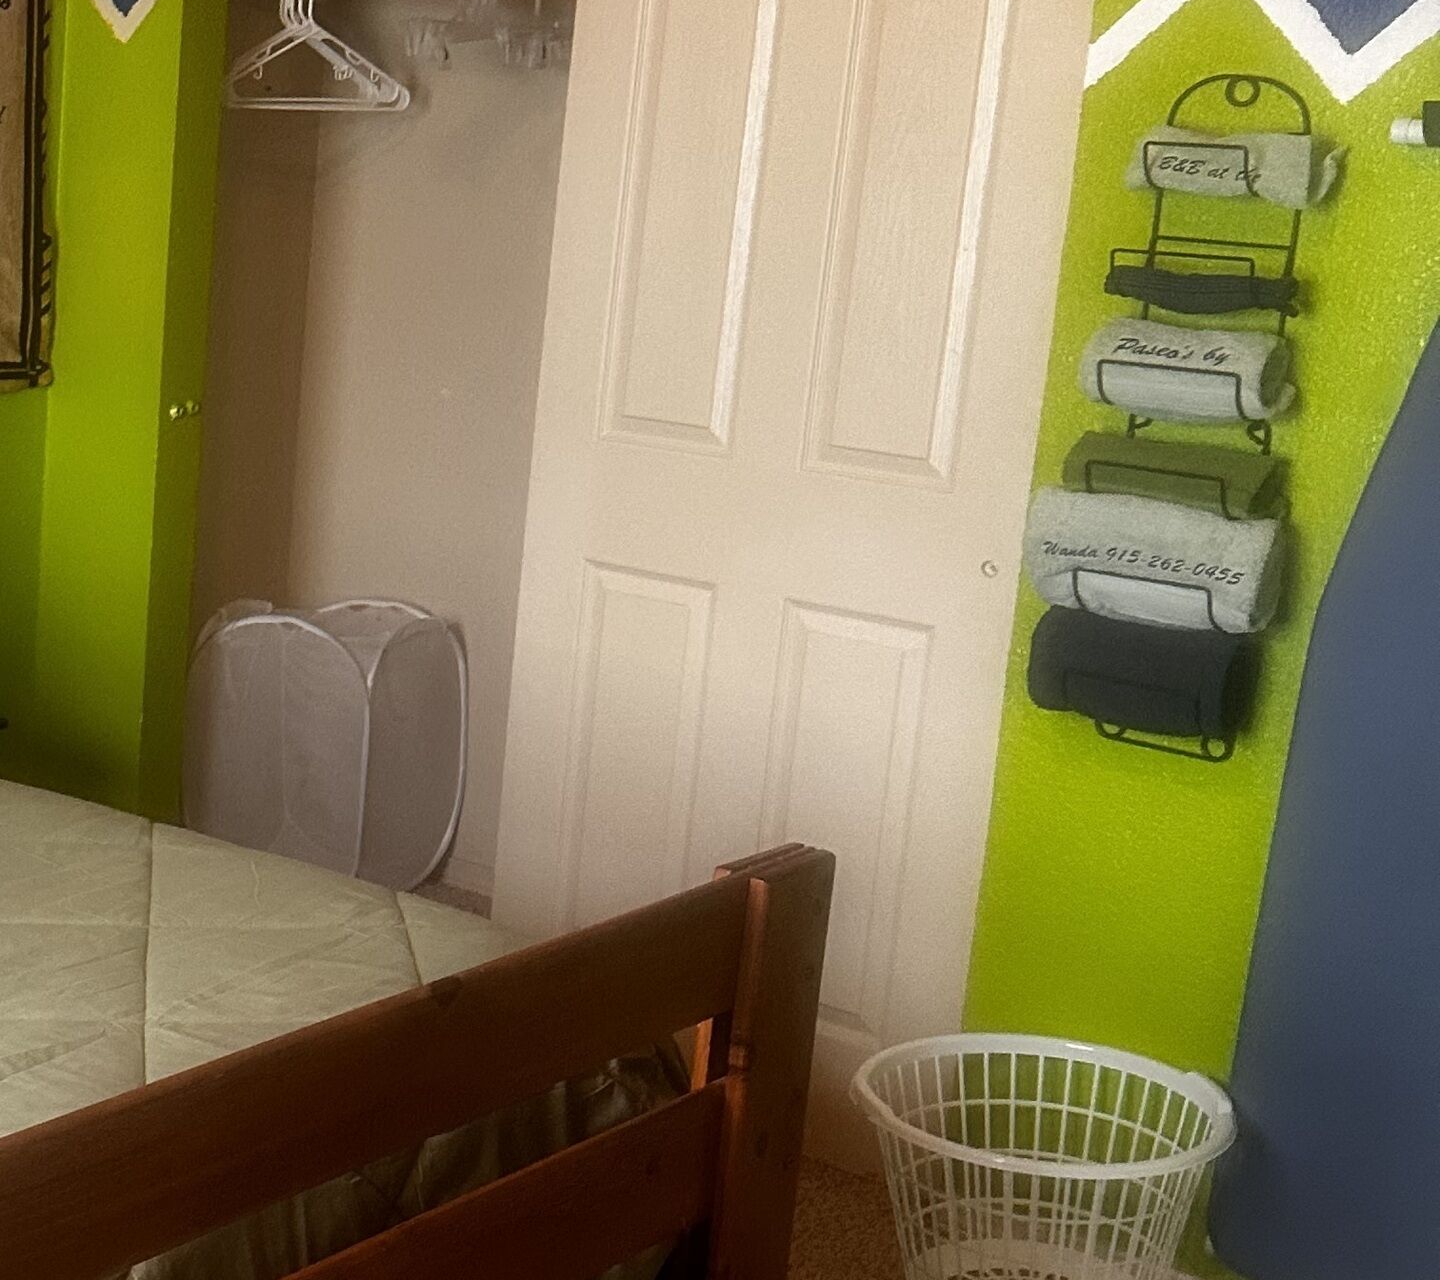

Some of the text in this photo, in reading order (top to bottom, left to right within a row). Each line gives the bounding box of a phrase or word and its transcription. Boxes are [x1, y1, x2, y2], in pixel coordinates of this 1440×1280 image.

[1159, 156, 1206, 175] B&B
[1207, 167, 1230, 179] at
[1202, 346, 1231, 366] by
[1043, 541, 1098, 558] Wanda
